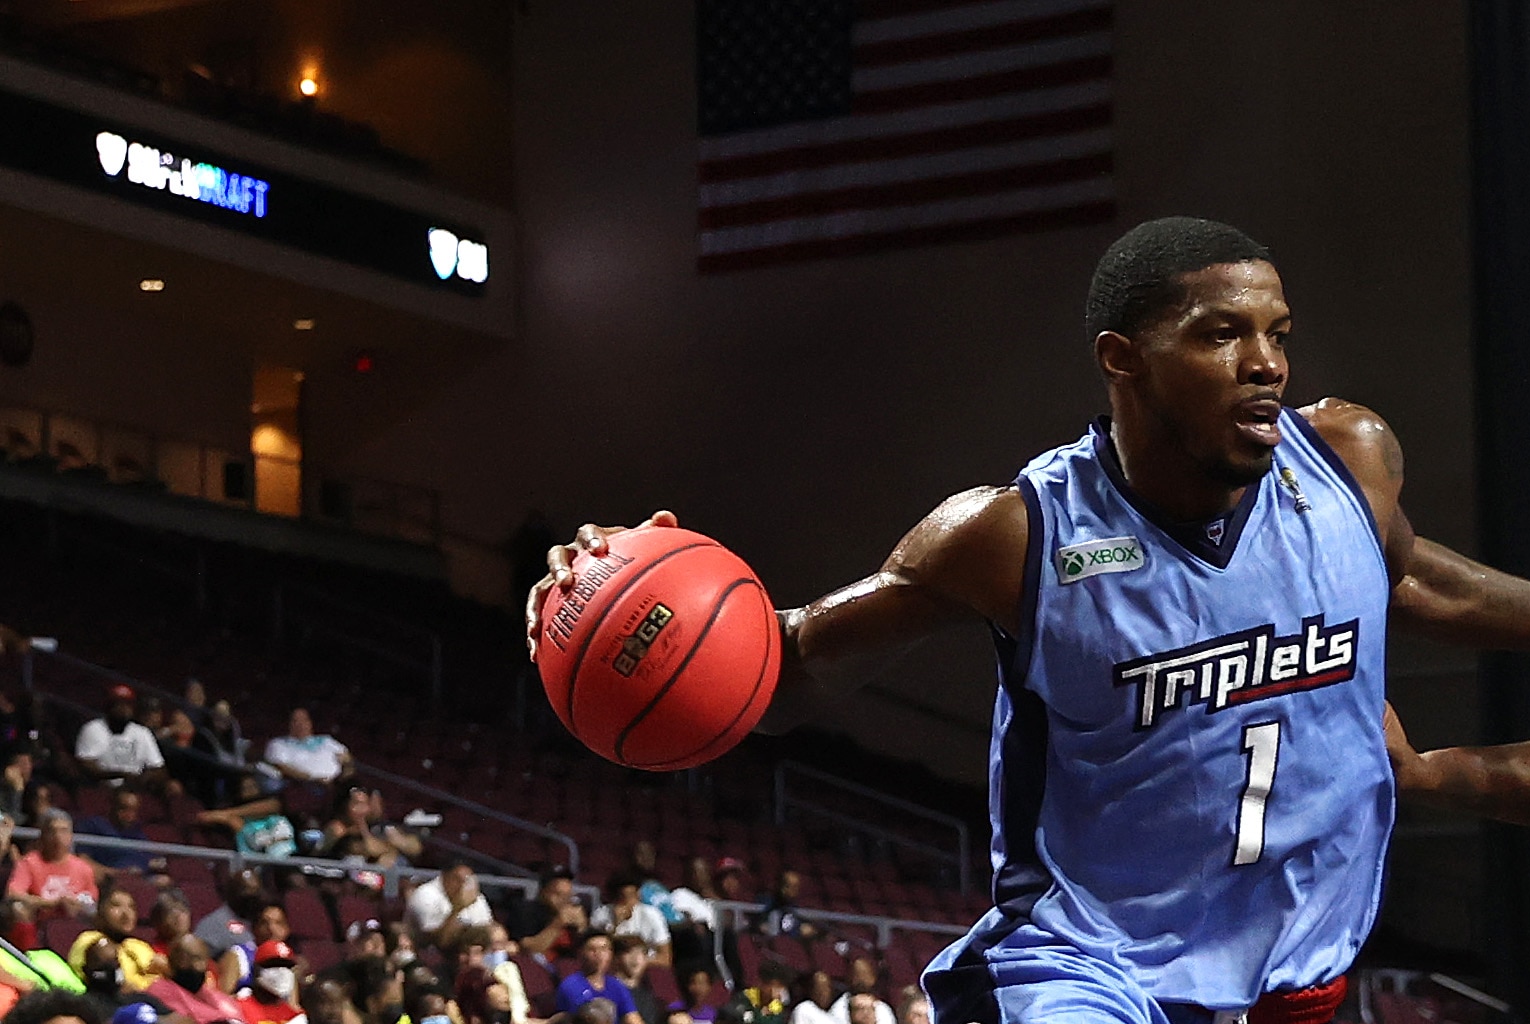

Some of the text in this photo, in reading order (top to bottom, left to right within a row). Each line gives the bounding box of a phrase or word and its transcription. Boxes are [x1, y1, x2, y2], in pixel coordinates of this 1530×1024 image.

[546, 551, 635, 654] FIREBALL
[1087, 546, 1139, 566] XBOX
[1120, 624, 1355, 727] Triplets
[1232, 721, 1281, 868] 1
